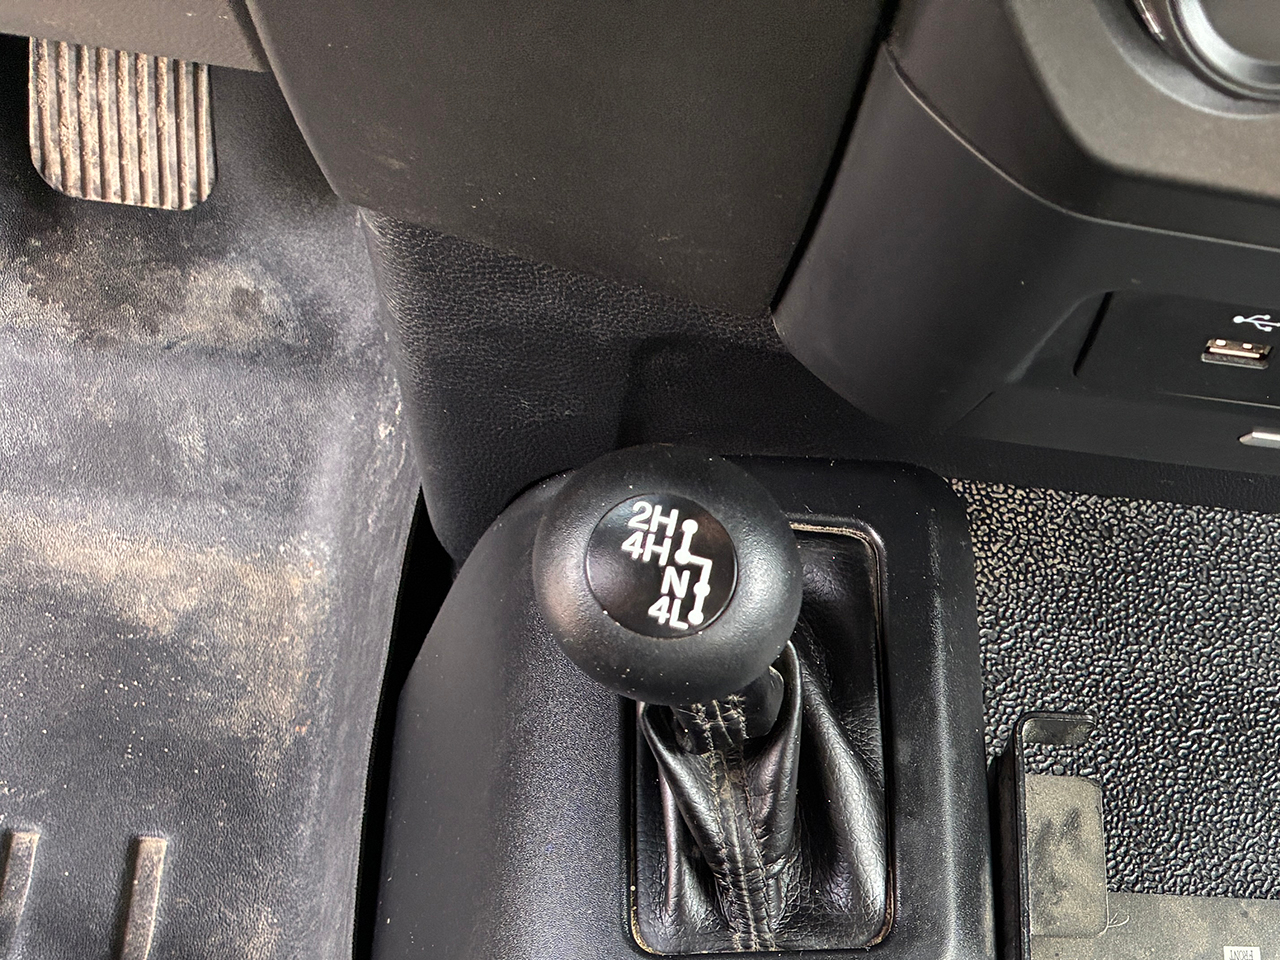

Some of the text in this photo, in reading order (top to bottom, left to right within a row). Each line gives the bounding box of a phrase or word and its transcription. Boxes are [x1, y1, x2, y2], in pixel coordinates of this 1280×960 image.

[627, 500, 679, 537] 2H
[621, 530, 672, 566] 4H
[661, 565, 691, 599] N
[647, 595, 689, 630] 4L
[1229, 949, 1254, 960] FRONT
